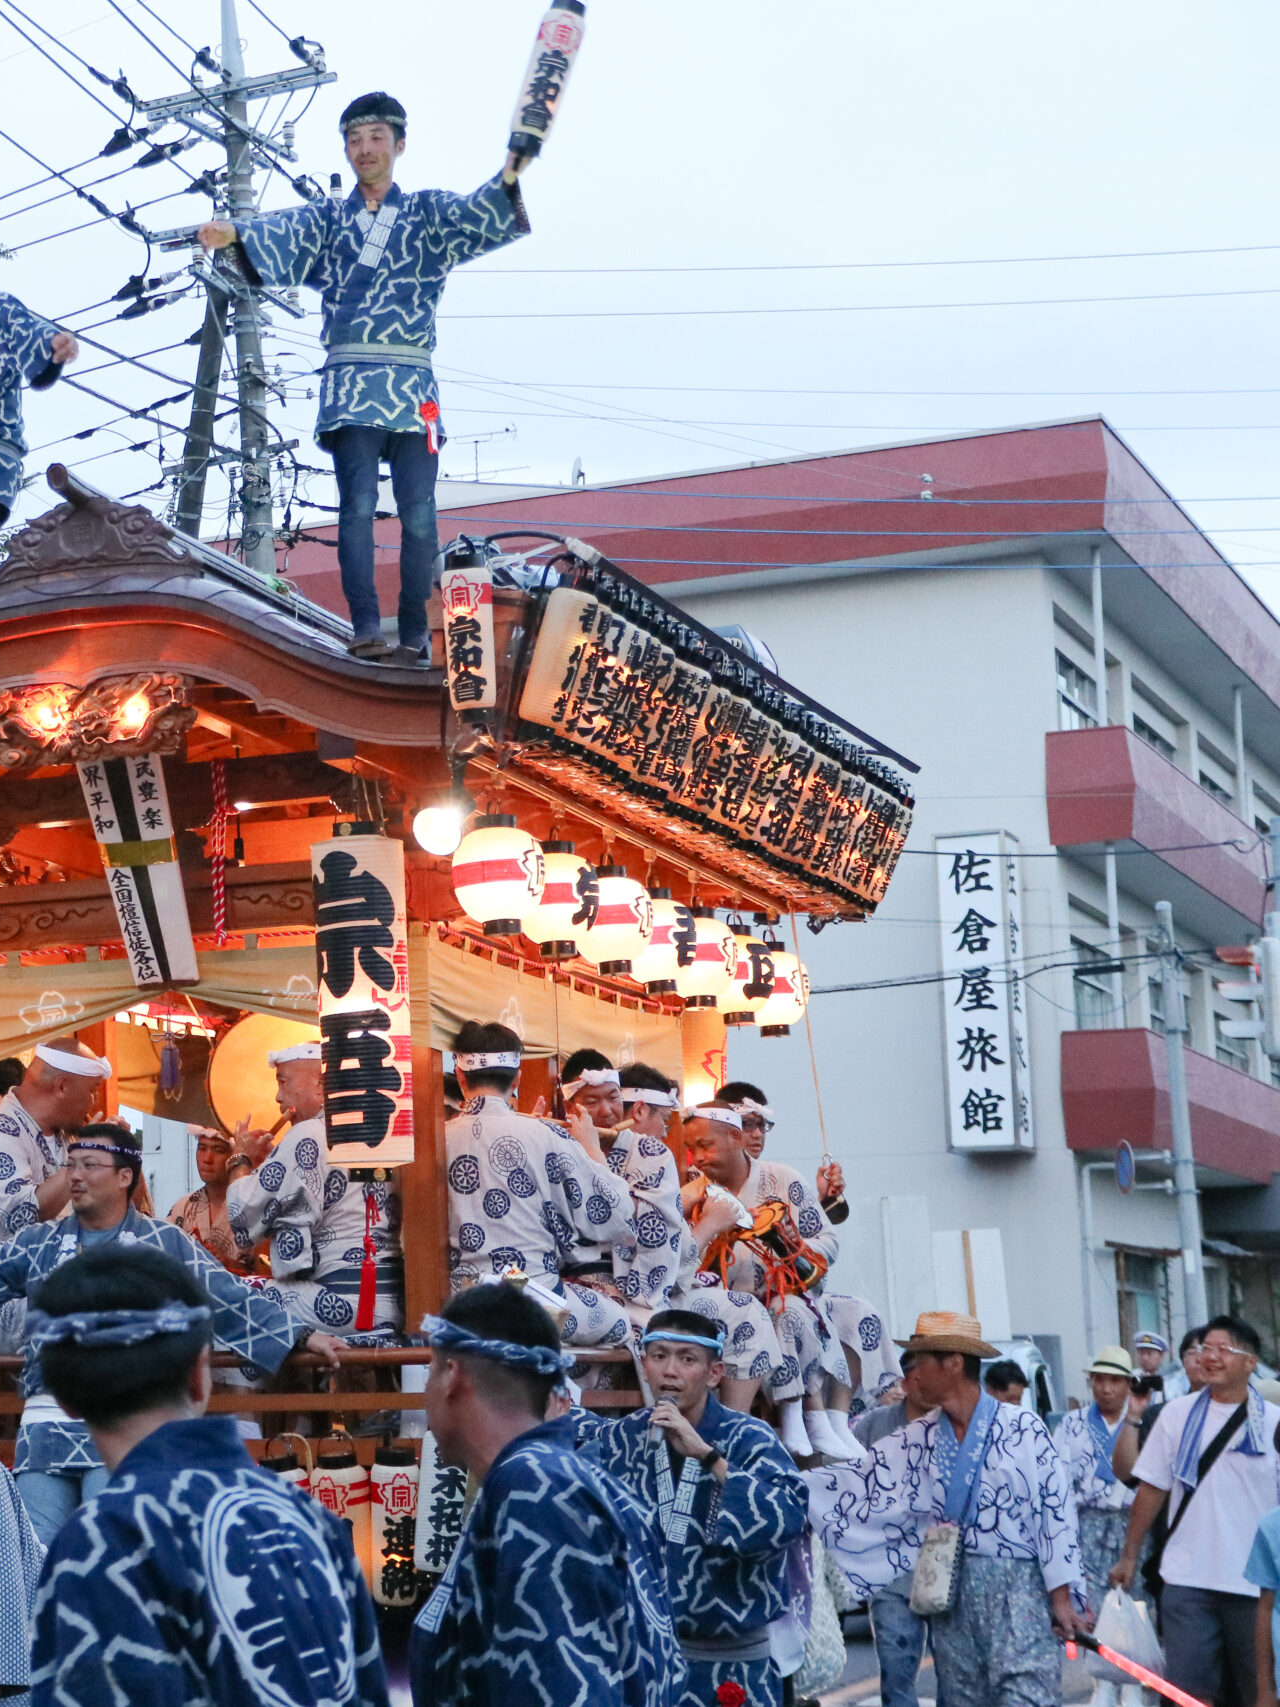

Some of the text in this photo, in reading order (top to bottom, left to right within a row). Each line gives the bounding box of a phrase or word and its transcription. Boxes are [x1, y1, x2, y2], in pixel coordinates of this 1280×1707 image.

[131, 752, 164, 830] 民豊楽
[110, 868, 160, 981] 全国檀信徒各位
[313, 851, 402, 1152] 宗吾
[948, 849, 1005, 1134] 佐倉屋旅館
